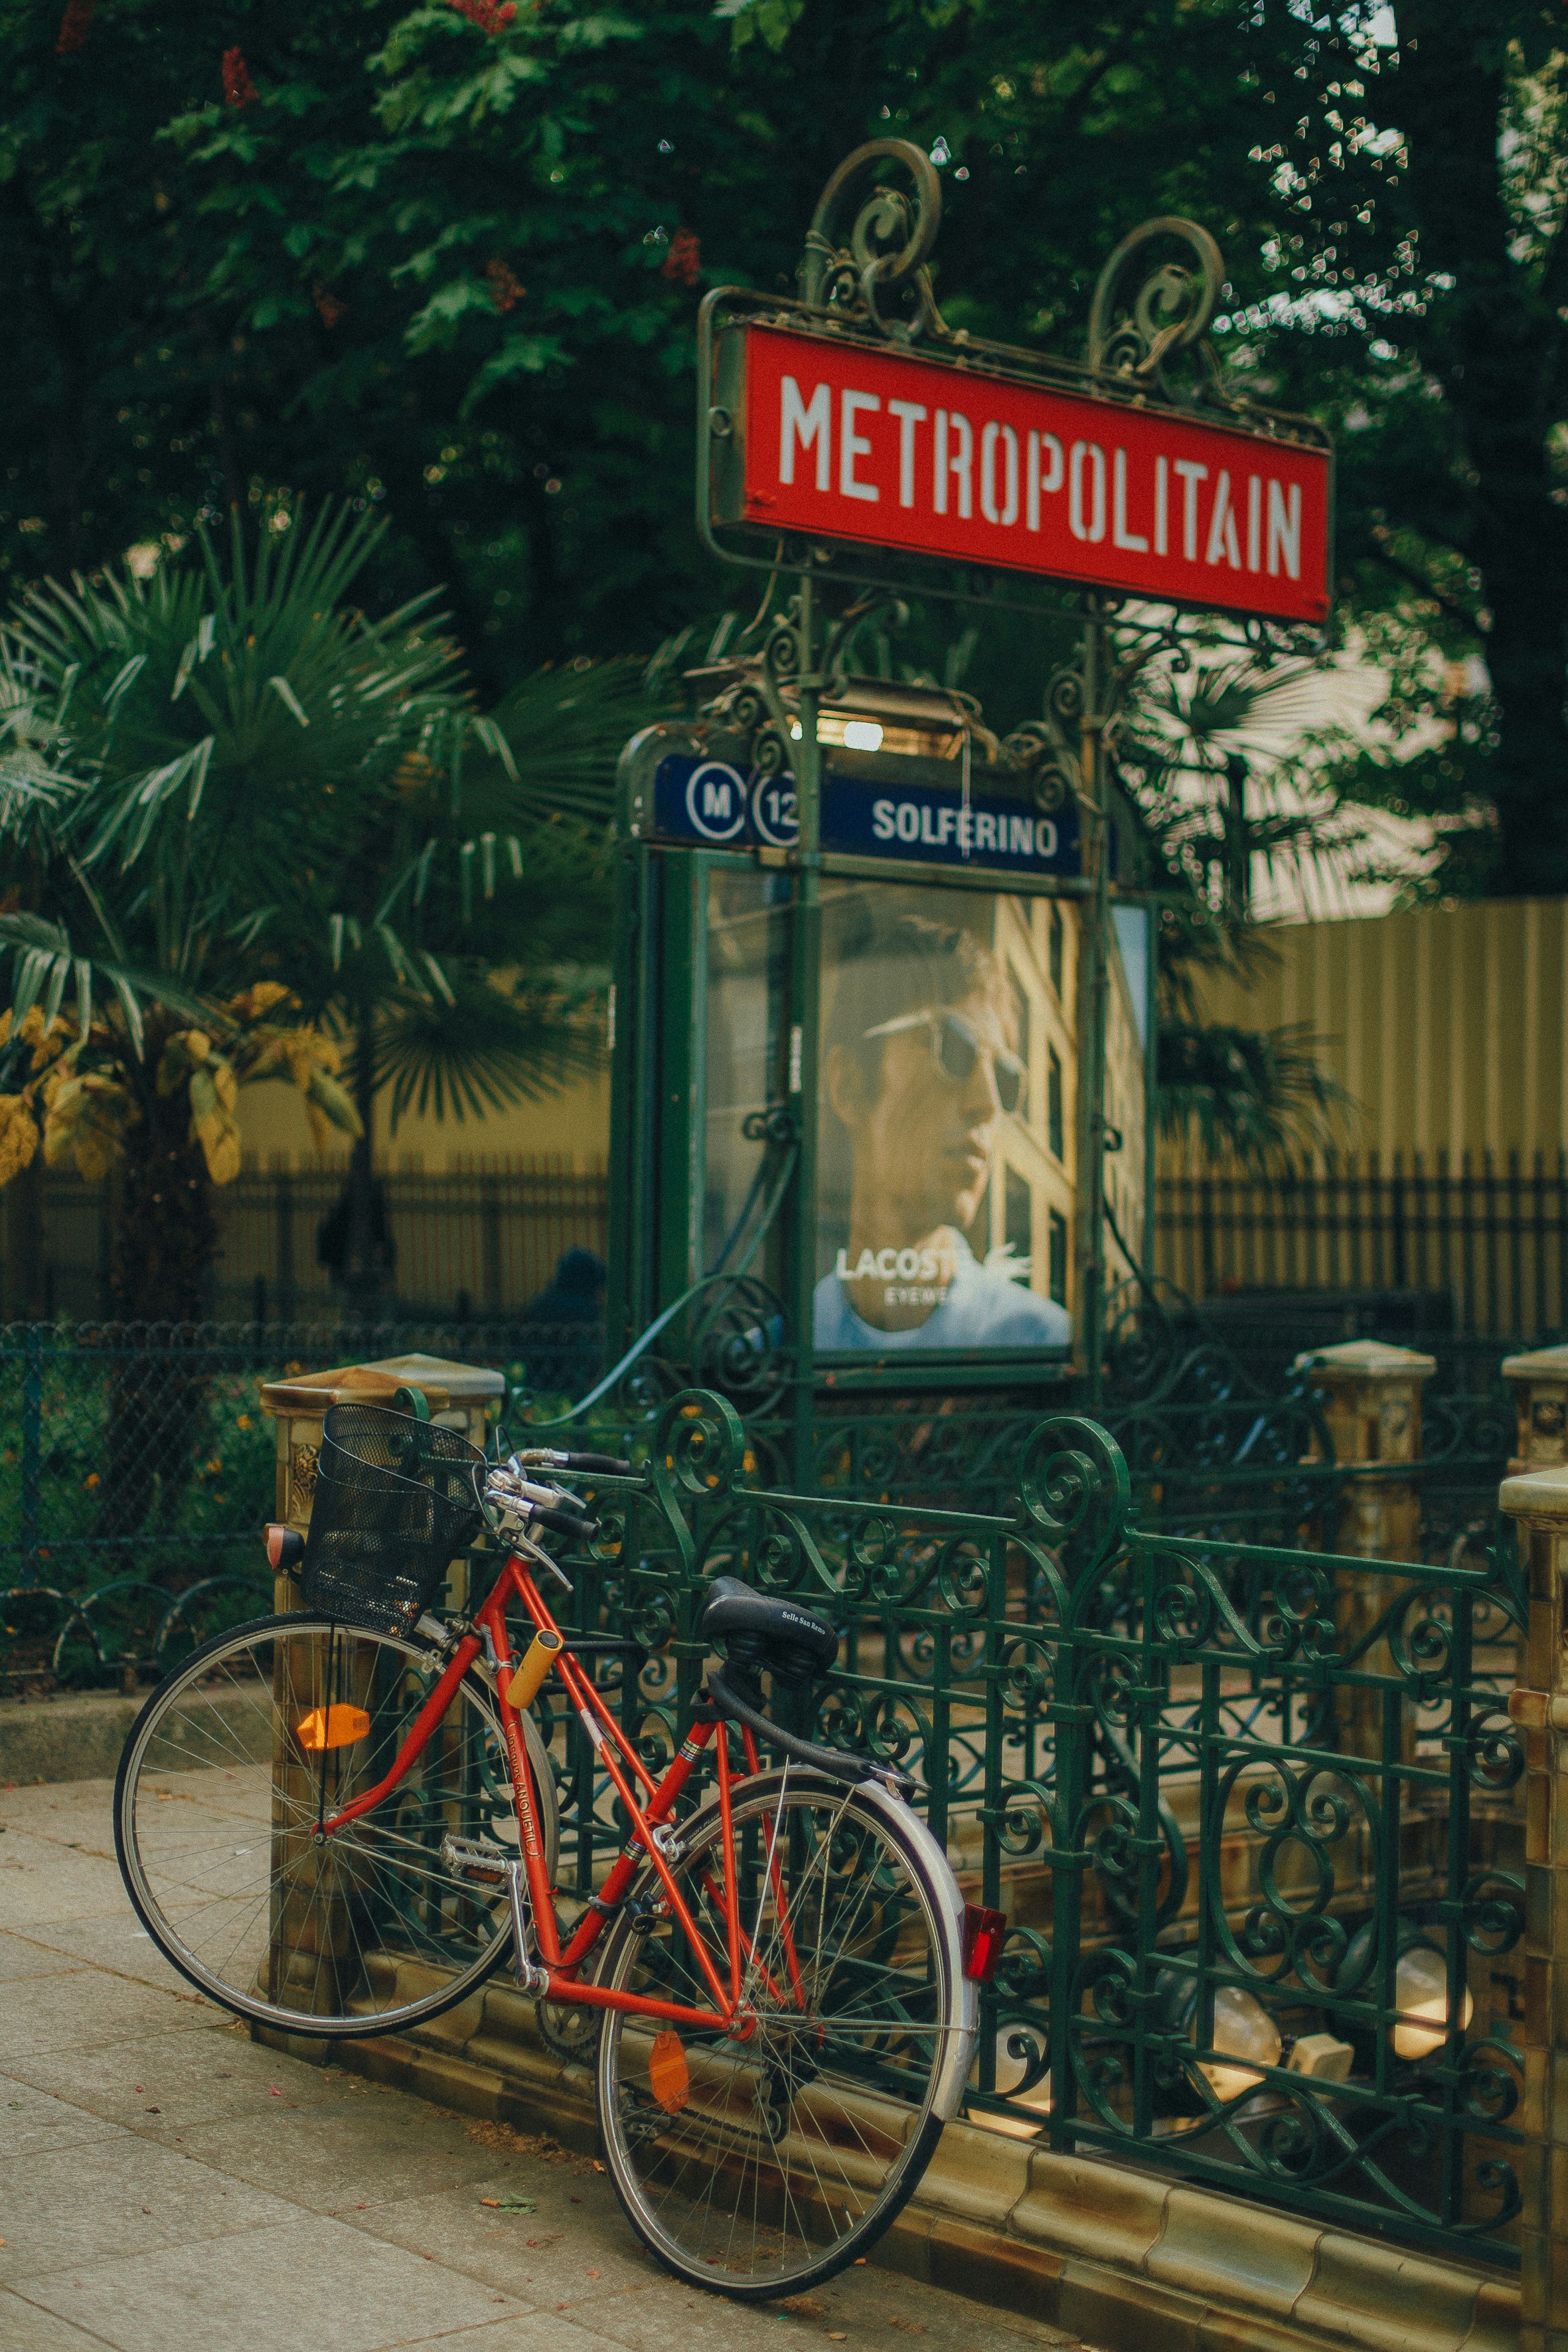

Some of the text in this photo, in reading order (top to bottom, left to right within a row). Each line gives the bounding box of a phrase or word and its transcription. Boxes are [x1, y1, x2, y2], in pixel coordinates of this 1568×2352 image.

[779, 375, 1302, 580] METROPOLITAIN
[704, 781, 732, 819] M
[765, 789, 799, 826] 12
[836, 1247, 957, 1281] LACOST
[884, 1286, 948, 1306] EYEWE
[782, 1611, 826, 1635] Selle San Remo
